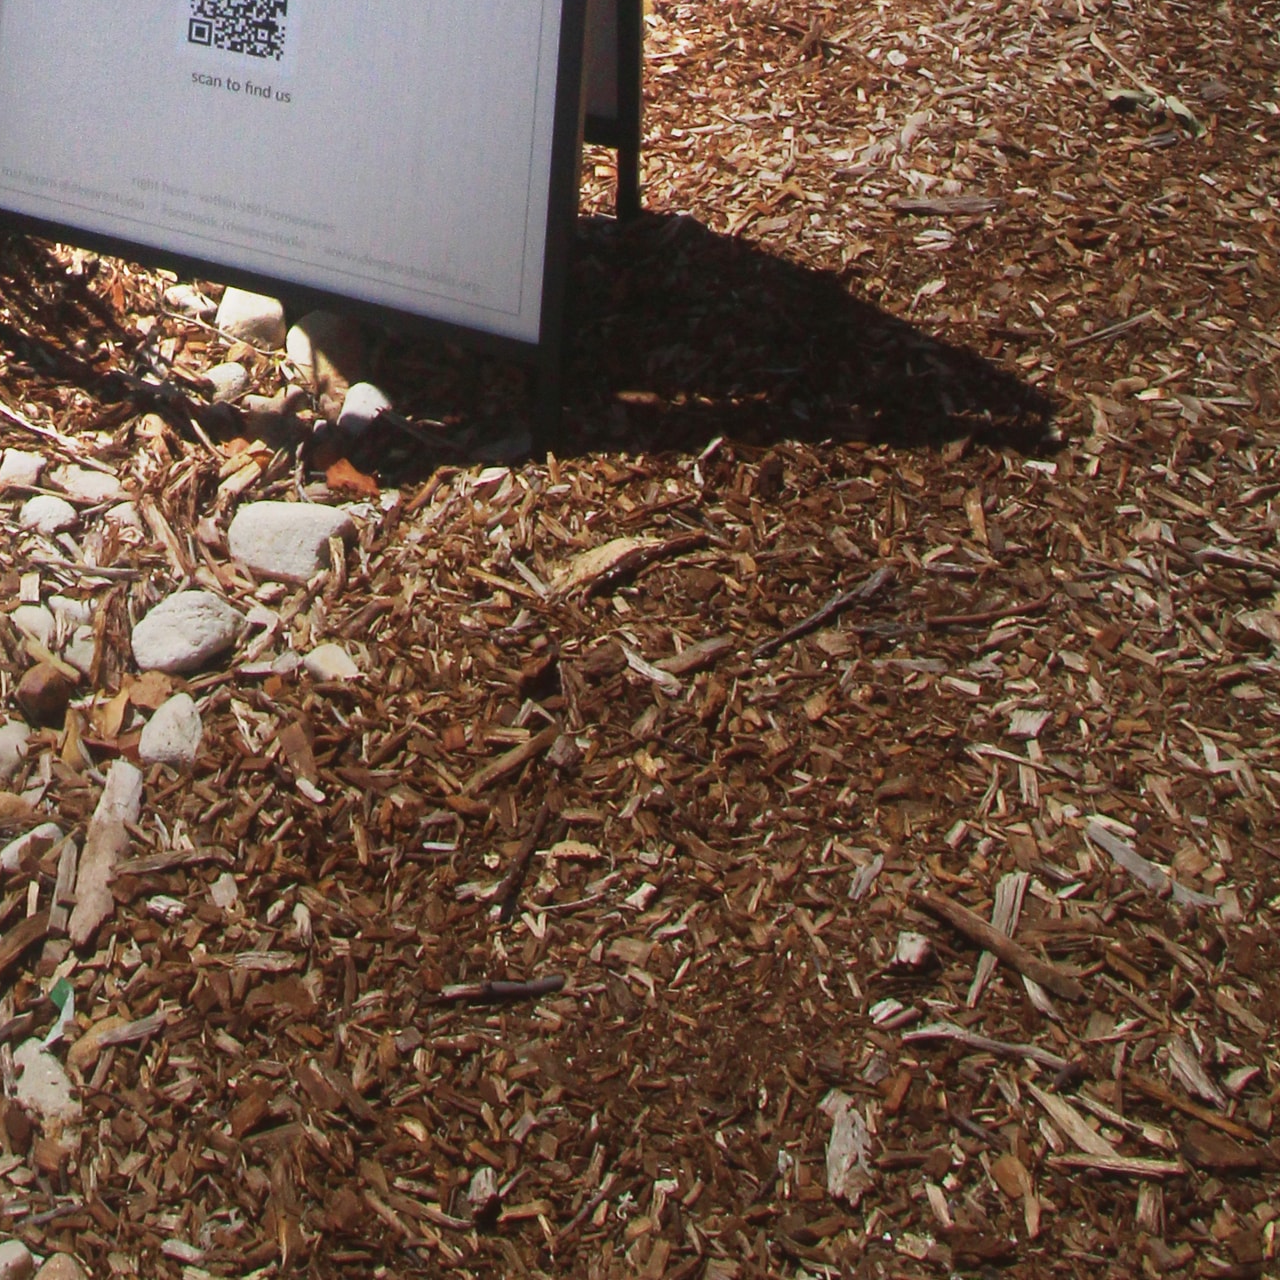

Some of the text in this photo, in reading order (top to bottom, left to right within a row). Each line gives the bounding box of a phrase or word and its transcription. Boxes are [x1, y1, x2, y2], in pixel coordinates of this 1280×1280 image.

[192, 72, 291, 103] scan to find us
